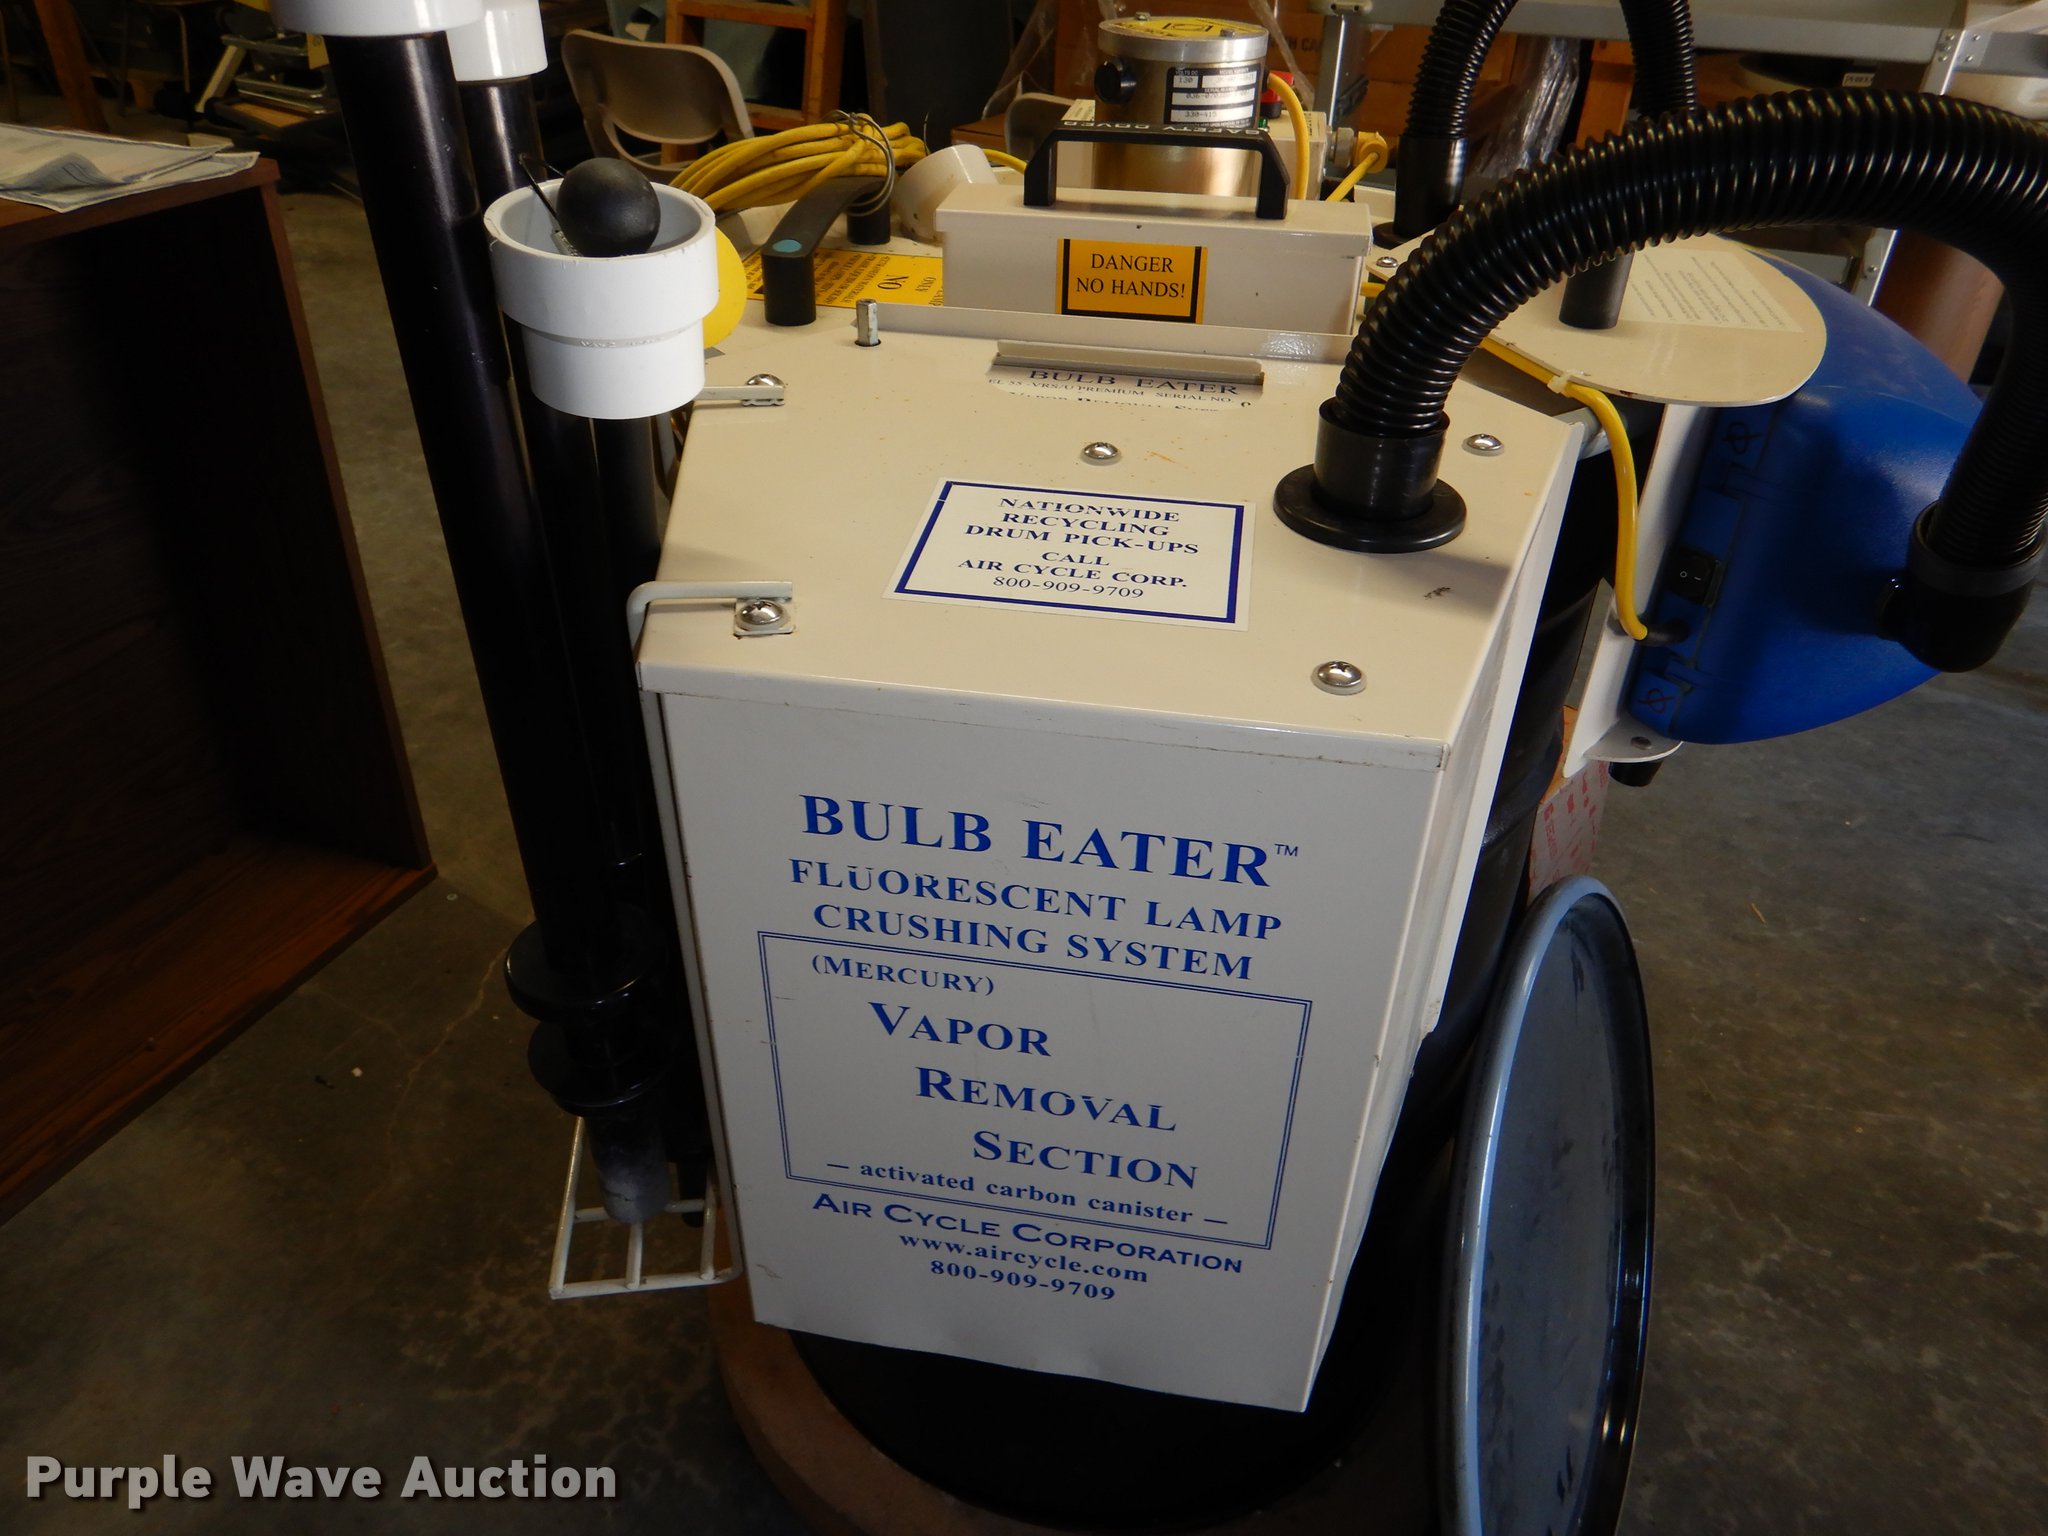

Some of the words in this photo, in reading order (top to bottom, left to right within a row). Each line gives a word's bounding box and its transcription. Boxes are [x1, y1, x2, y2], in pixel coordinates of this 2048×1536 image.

[1091, 253, 1173, 273] DANGER
[1076, 277, 1104, 294] NO
[1111, 279, 1185, 298] HANDS!
[1030, 370, 1116, 385] BULB
[1136, 377, 1239, 395] EATER
[1077, 385, 1145, 396] PREMIUM
[1156, 391, 1205, 401] SERIAL
[998, 498, 1180, 522] NATIONWIDE
[1002, 512, 1170, 537] RECYCLING
[964, 525, 1053, 542] DRUM
[1063, 533, 1200, 555] PICK-UPS
[1041, 552, 1111, 566] CALL
[957, 559, 1003, 572] AIR
[1014, 564, 1101, 581] CYCLE
[1111, 572, 1188, 588] CORP.
[993, 576, 1145, 600] 800-909-9709
[798, 794, 993, 854] BULB
[788, 857, 1126, 922] FLUORESCENT
[1144, 900, 1283, 942] LAMP
[812, 904, 1049, 955] CRUSHING
[1066, 933, 1253, 981] SYSTEM
[811, 954, 995, 997] (MERCURY)
[867, 1001, 1052, 1058] VAPOR
[914, 1066, 1178, 1133] REMOVAL
[972, 1129, 1199, 1190] SECTION
[860, 1162, 974, 1192] activated
[985, 1180, 1077, 1207] carbon
[1088, 1196, 1194, 1225] canister
[812, 1193, 873, 1218] AIR
[883, 1203, 1001, 1238] CYCLE
[1012, 1222, 1243, 1274] CORPORATION
[898, 1234, 1149, 1283] www.aircycle.com
[930, 1259, 1116, 1301] 800-909-9709
